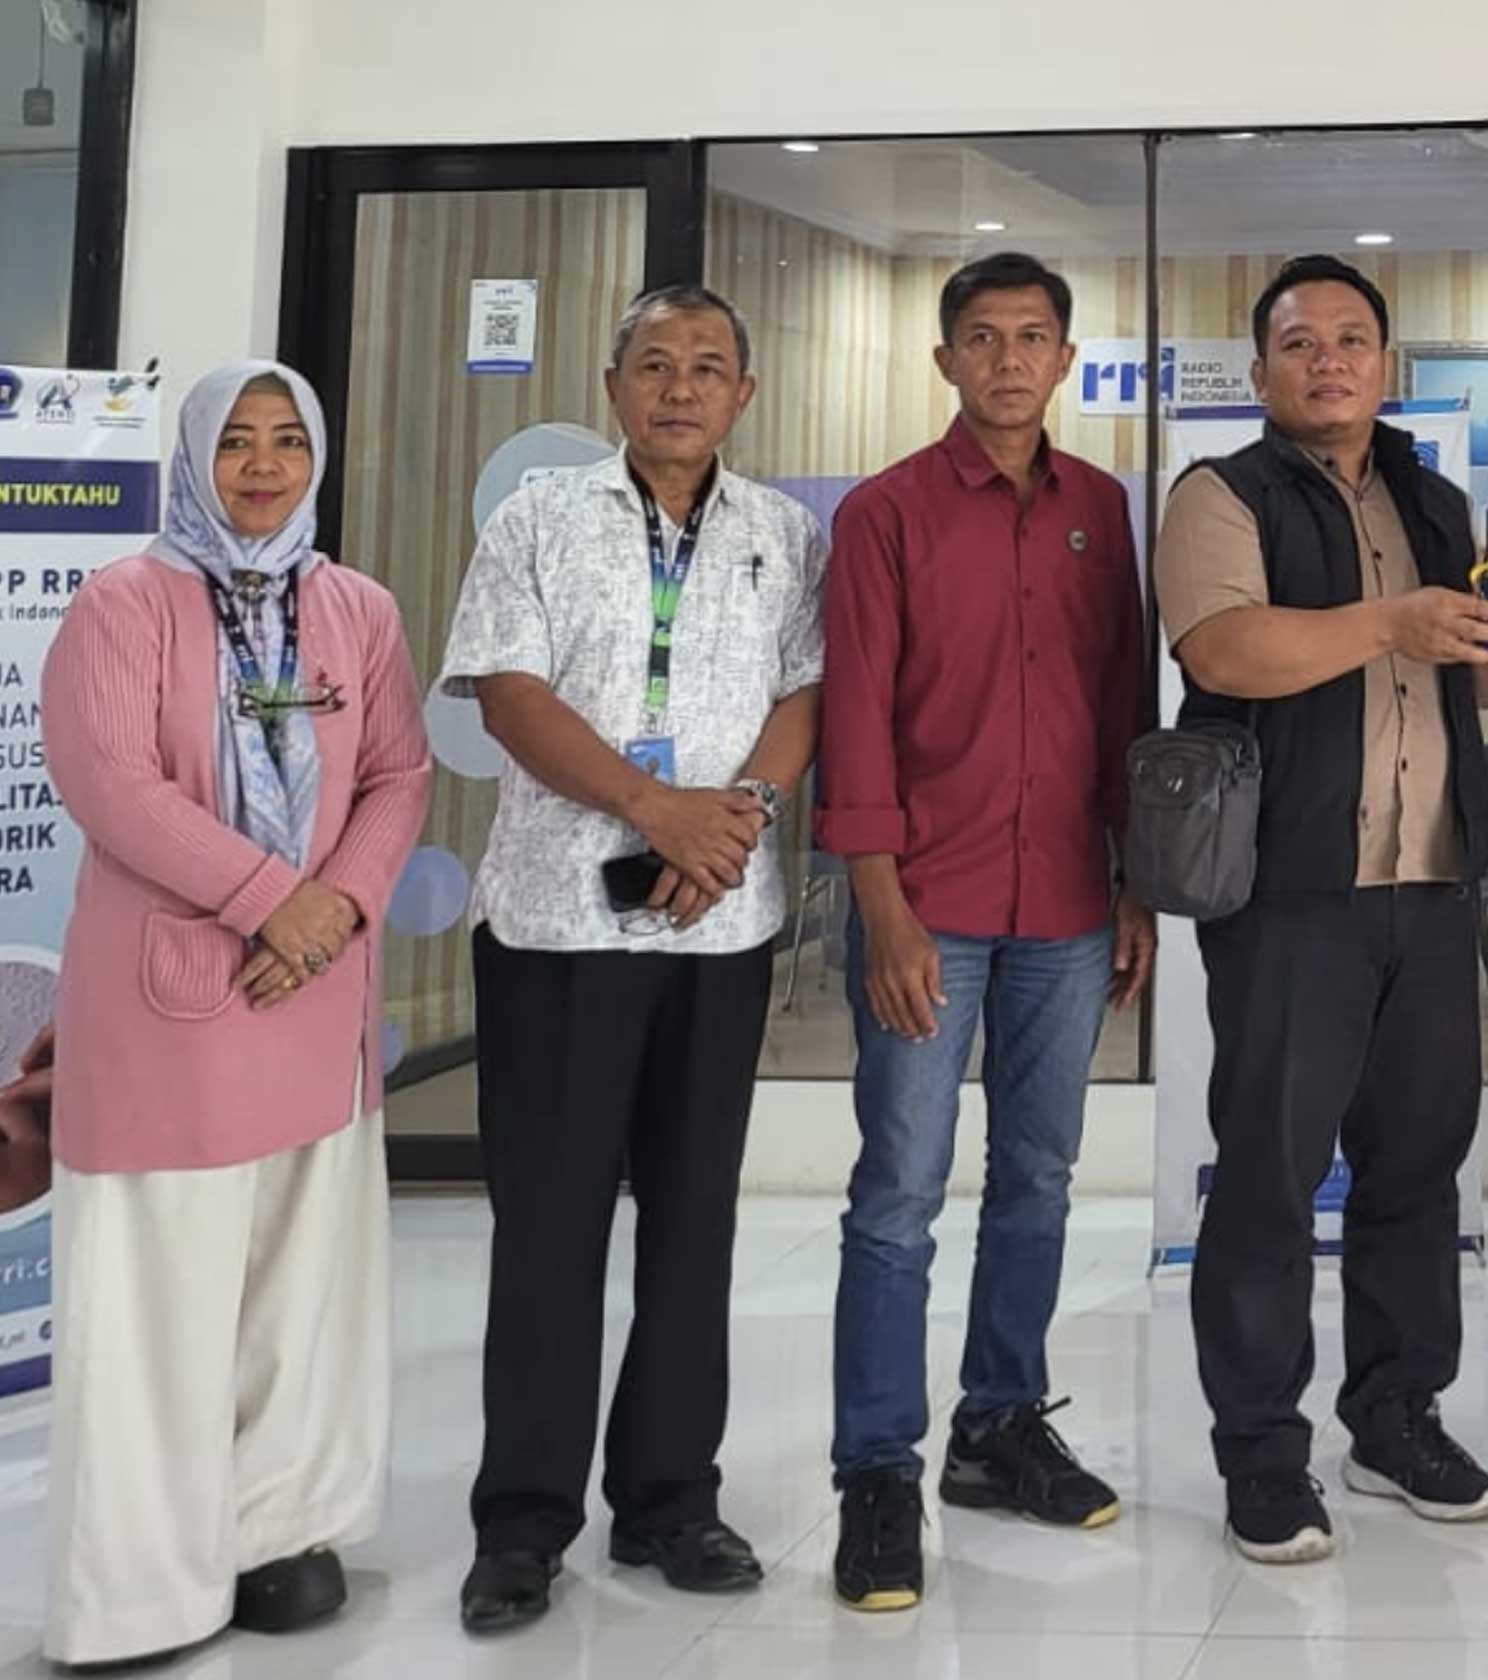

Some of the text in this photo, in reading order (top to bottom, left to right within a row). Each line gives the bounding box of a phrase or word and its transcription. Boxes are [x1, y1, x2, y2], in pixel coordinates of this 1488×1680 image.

[1181, 361, 1222, 373] RADIO
[0, 569, 97, 595] P RR
[0, 782, 63, 810] ITA
[0, 821, 56, 851] RIK
